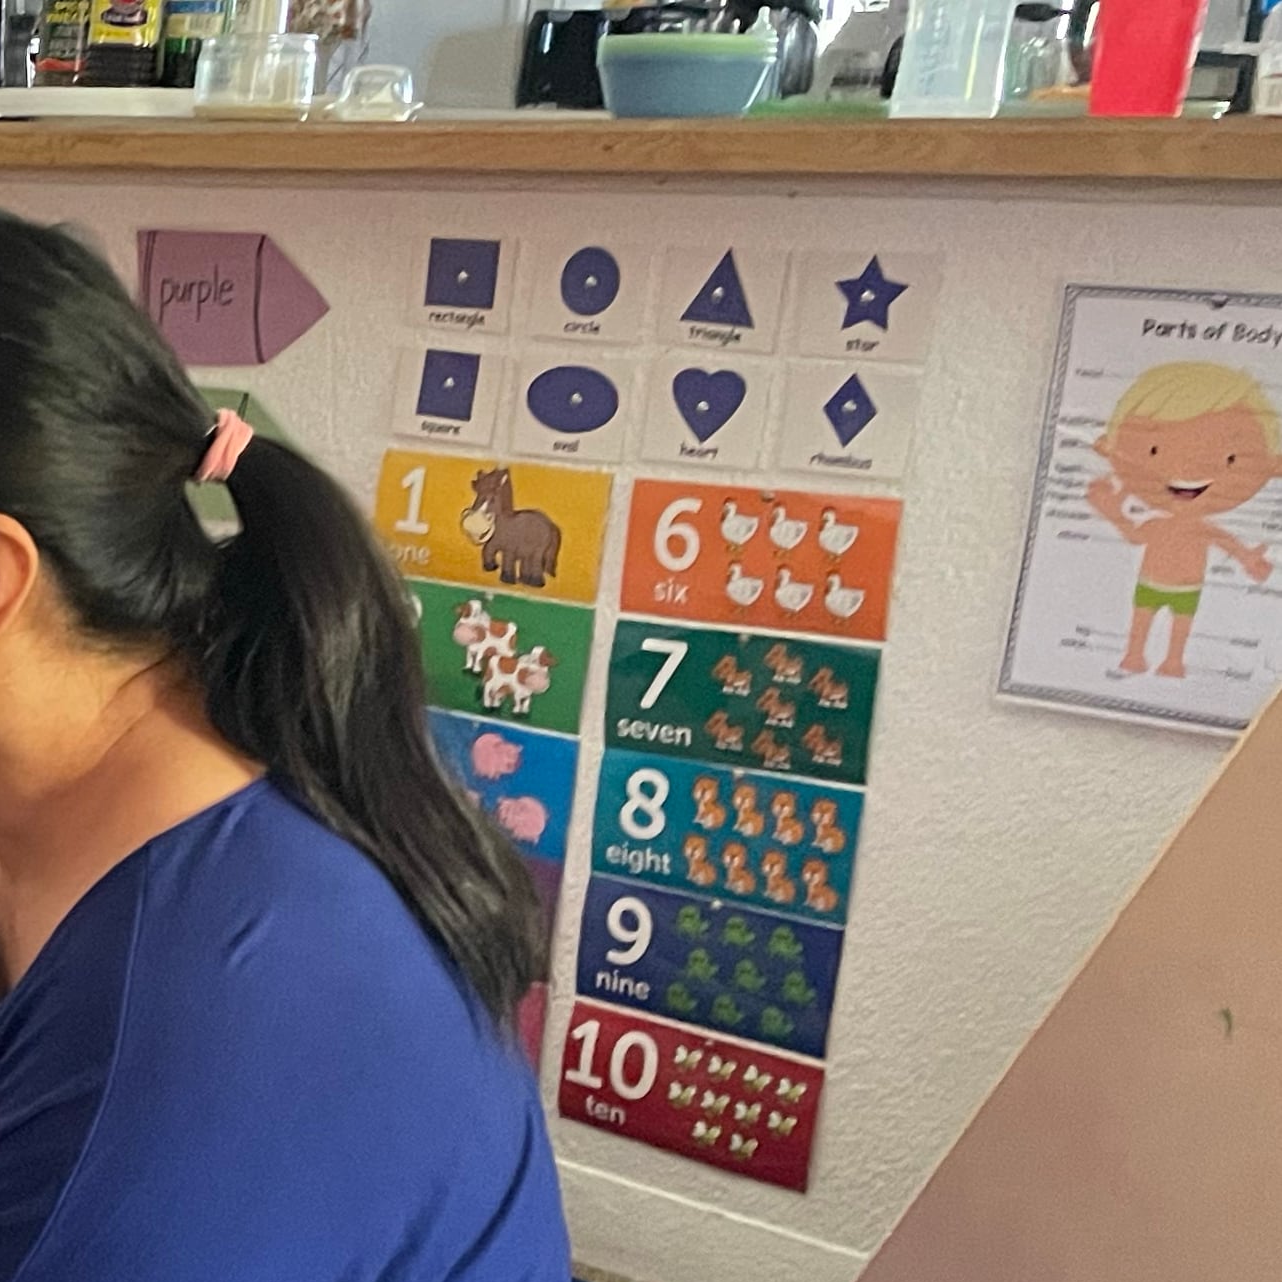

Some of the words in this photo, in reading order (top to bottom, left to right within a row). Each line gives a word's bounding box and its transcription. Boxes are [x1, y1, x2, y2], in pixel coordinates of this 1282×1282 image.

[158, 264, 235, 322] purple
[428, 311, 487, 329] rectangle
[563, 321, 601, 335] circle
[688, 325, 742, 347] triangle
[1142, 318, 1197, 339] Parts
[1202, 321, 1228, 340] of
[1232, 322, 1282, 349] Body
[845, 338, 880, 351] star
[393, 466, 430, 535] 1
[653, 497, 703, 572] 6
[652, 579, 690, 605] six
[639, 638, 690, 710] 7
[616, 716, 693, 747] seven
[619, 768, 671, 840] 8
[605, 840, 672, 875] eight
[605, 896, 653, 966] 9
[595, 968, 651, 1000] nine
[564, 1018, 660, 1101] 10
[585, 1094, 627, 1126] ten
